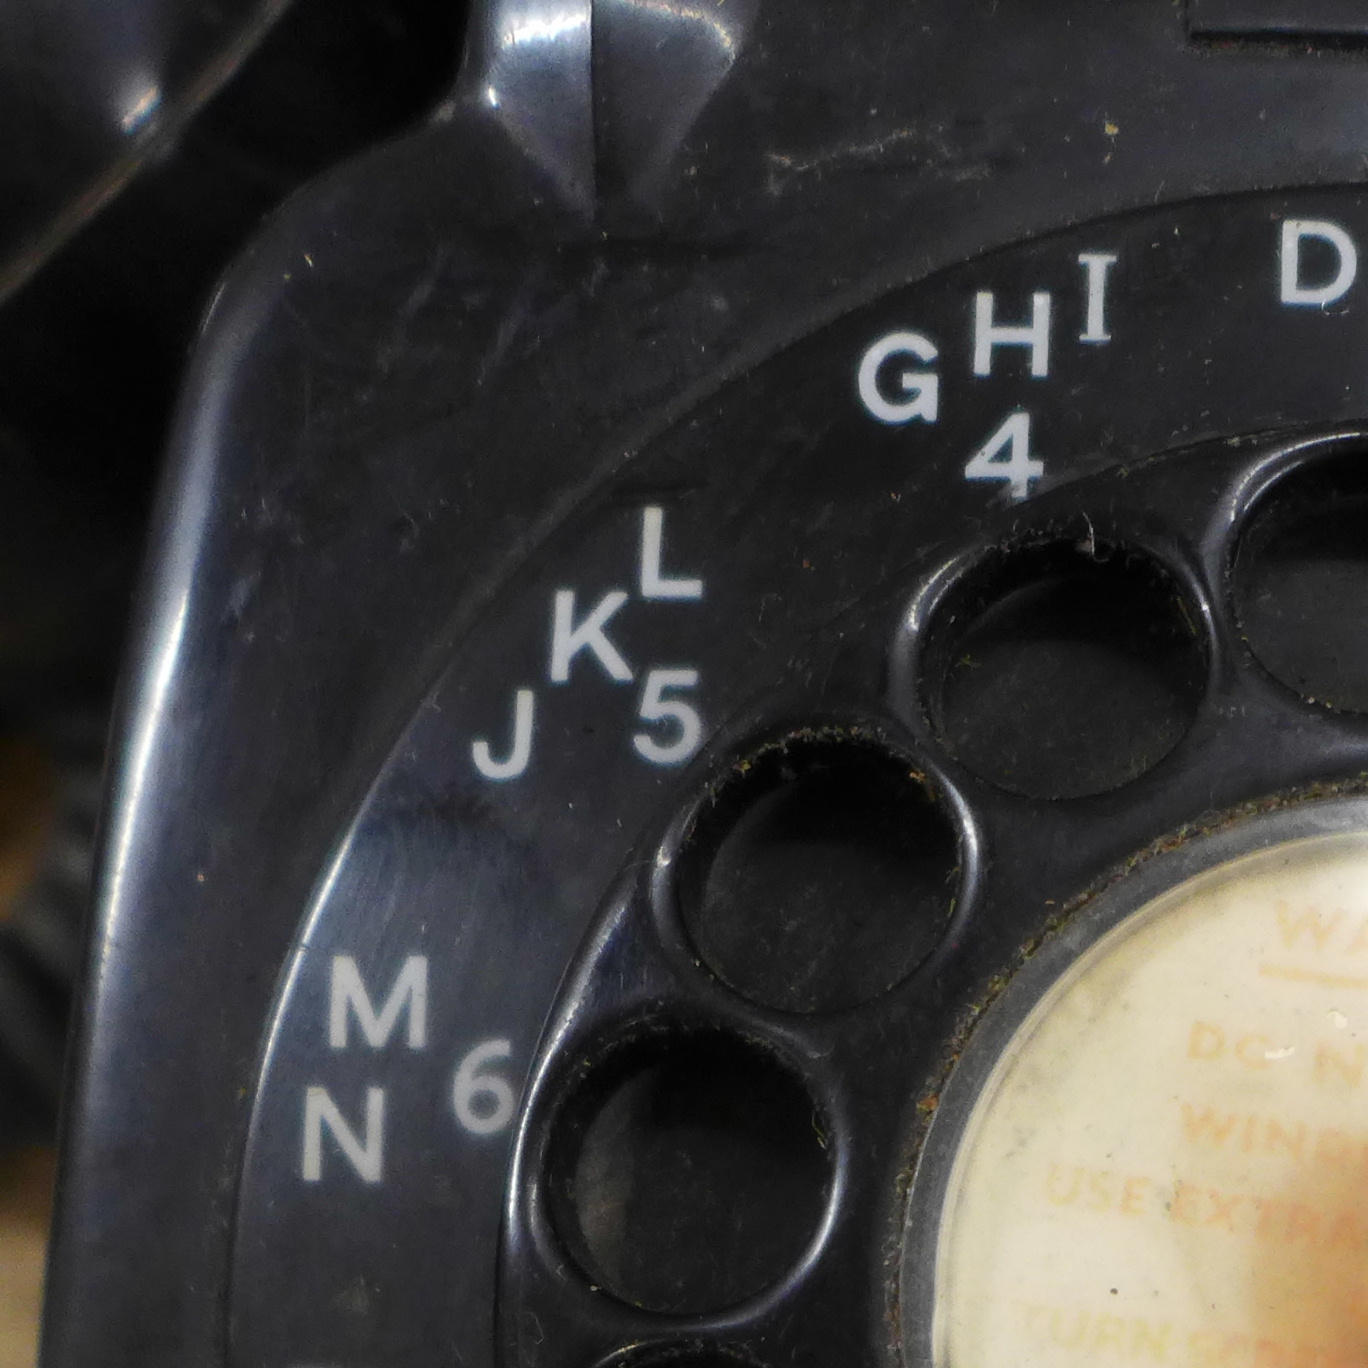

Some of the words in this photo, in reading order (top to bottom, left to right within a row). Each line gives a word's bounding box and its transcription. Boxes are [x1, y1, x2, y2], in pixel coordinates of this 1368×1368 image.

[856, 250, 1119, 425] GHI
[962, 409, 1047, 503] 4
[632, 667, 704, 765] 5
[450, 1038, 516, 1136] 6
[1045, 1164, 1152, 1218] USE
